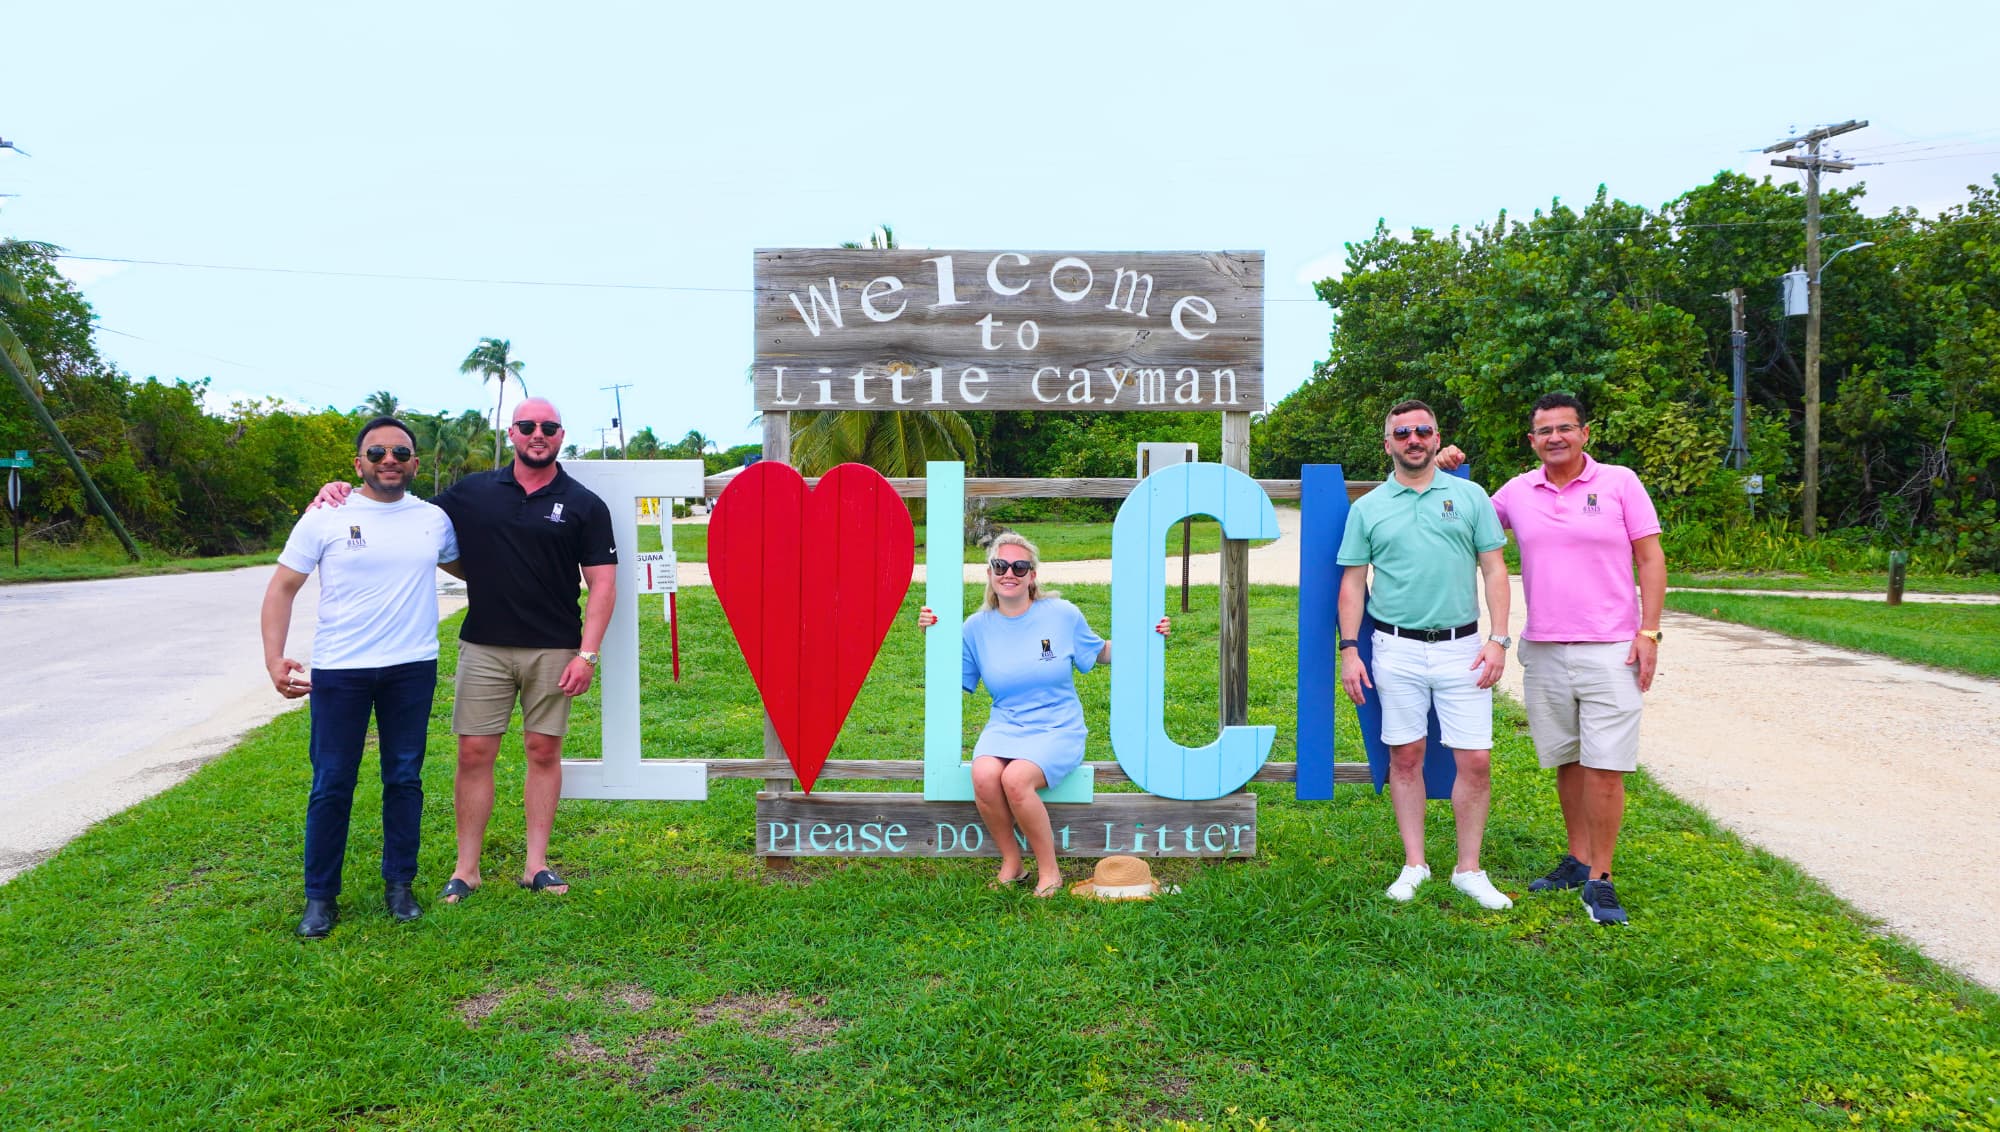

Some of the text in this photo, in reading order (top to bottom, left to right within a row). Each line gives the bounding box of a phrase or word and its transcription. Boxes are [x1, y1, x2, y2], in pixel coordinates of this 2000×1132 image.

[788, 253, 1217, 340] Welcome
[975, 313, 1040, 351] to
[772, 366, 1243, 405] Little Cayman
[768, 822, 908, 853] Please
[1012, 822, 1078, 853] Nt
[1105, 822, 1250, 853] Litter
